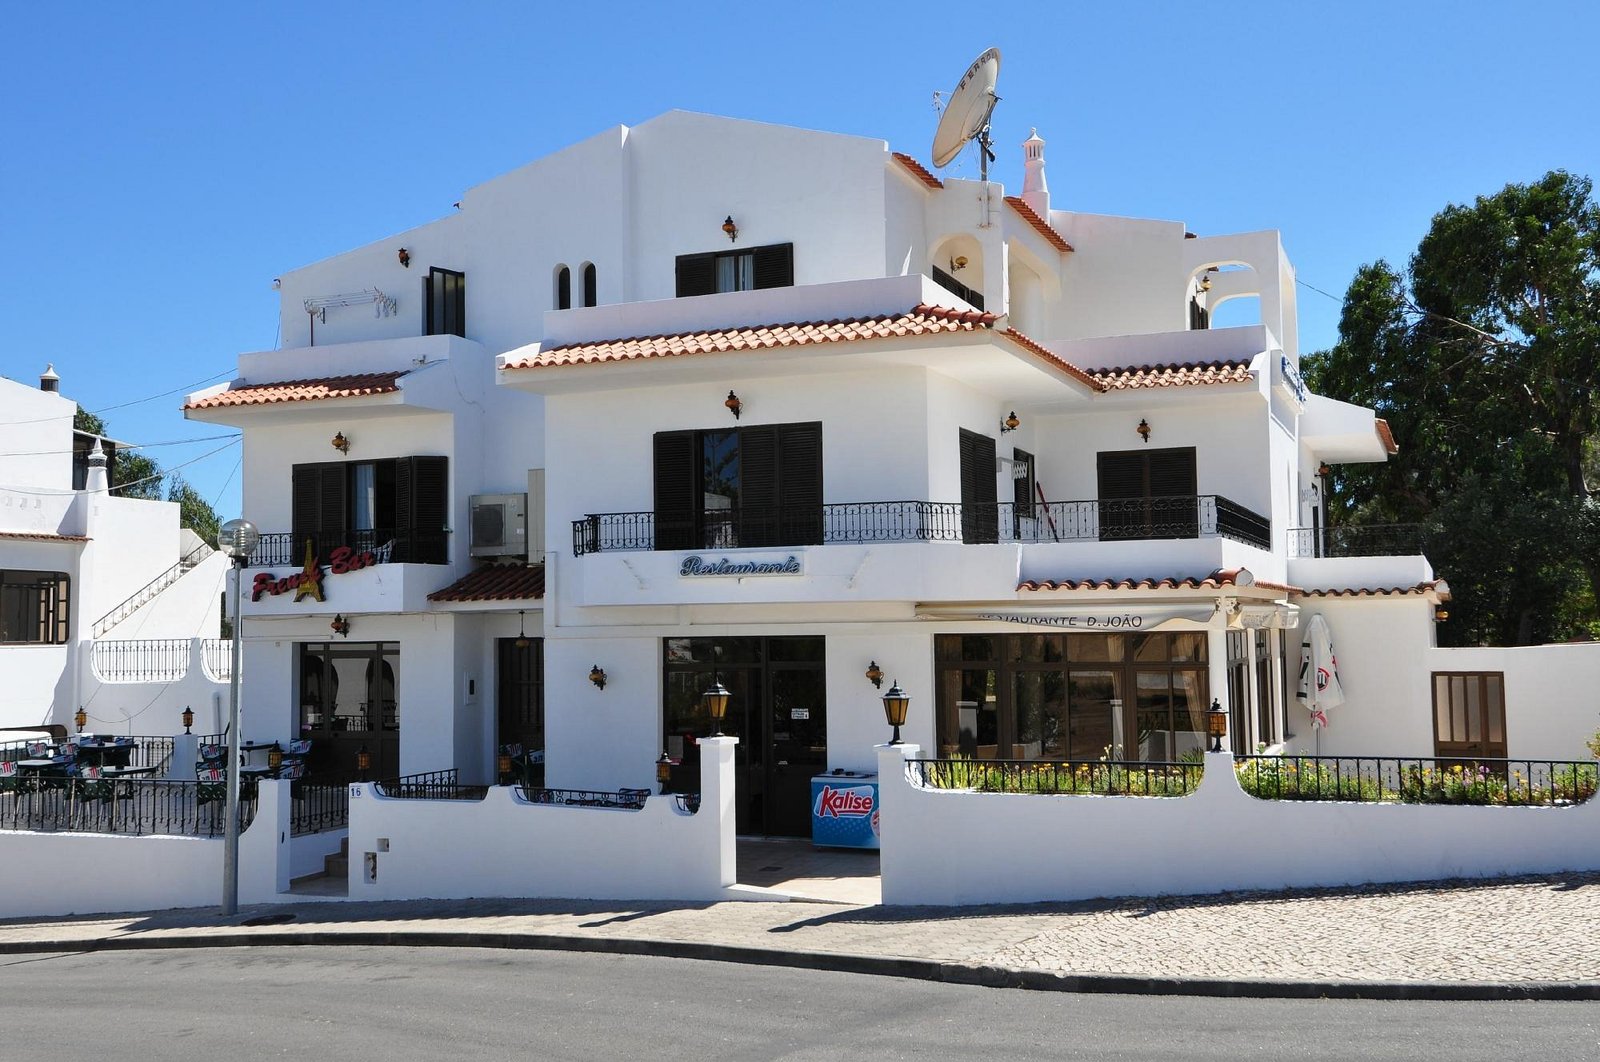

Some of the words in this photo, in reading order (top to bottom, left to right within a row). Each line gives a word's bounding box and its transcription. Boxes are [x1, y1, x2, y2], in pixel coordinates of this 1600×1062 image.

[329, 546, 376, 574] Bar
[680, 556, 800, 576] Restaurante
[351, 787, 361, 797] 16
[819, 786, 874, 818] Kalise
